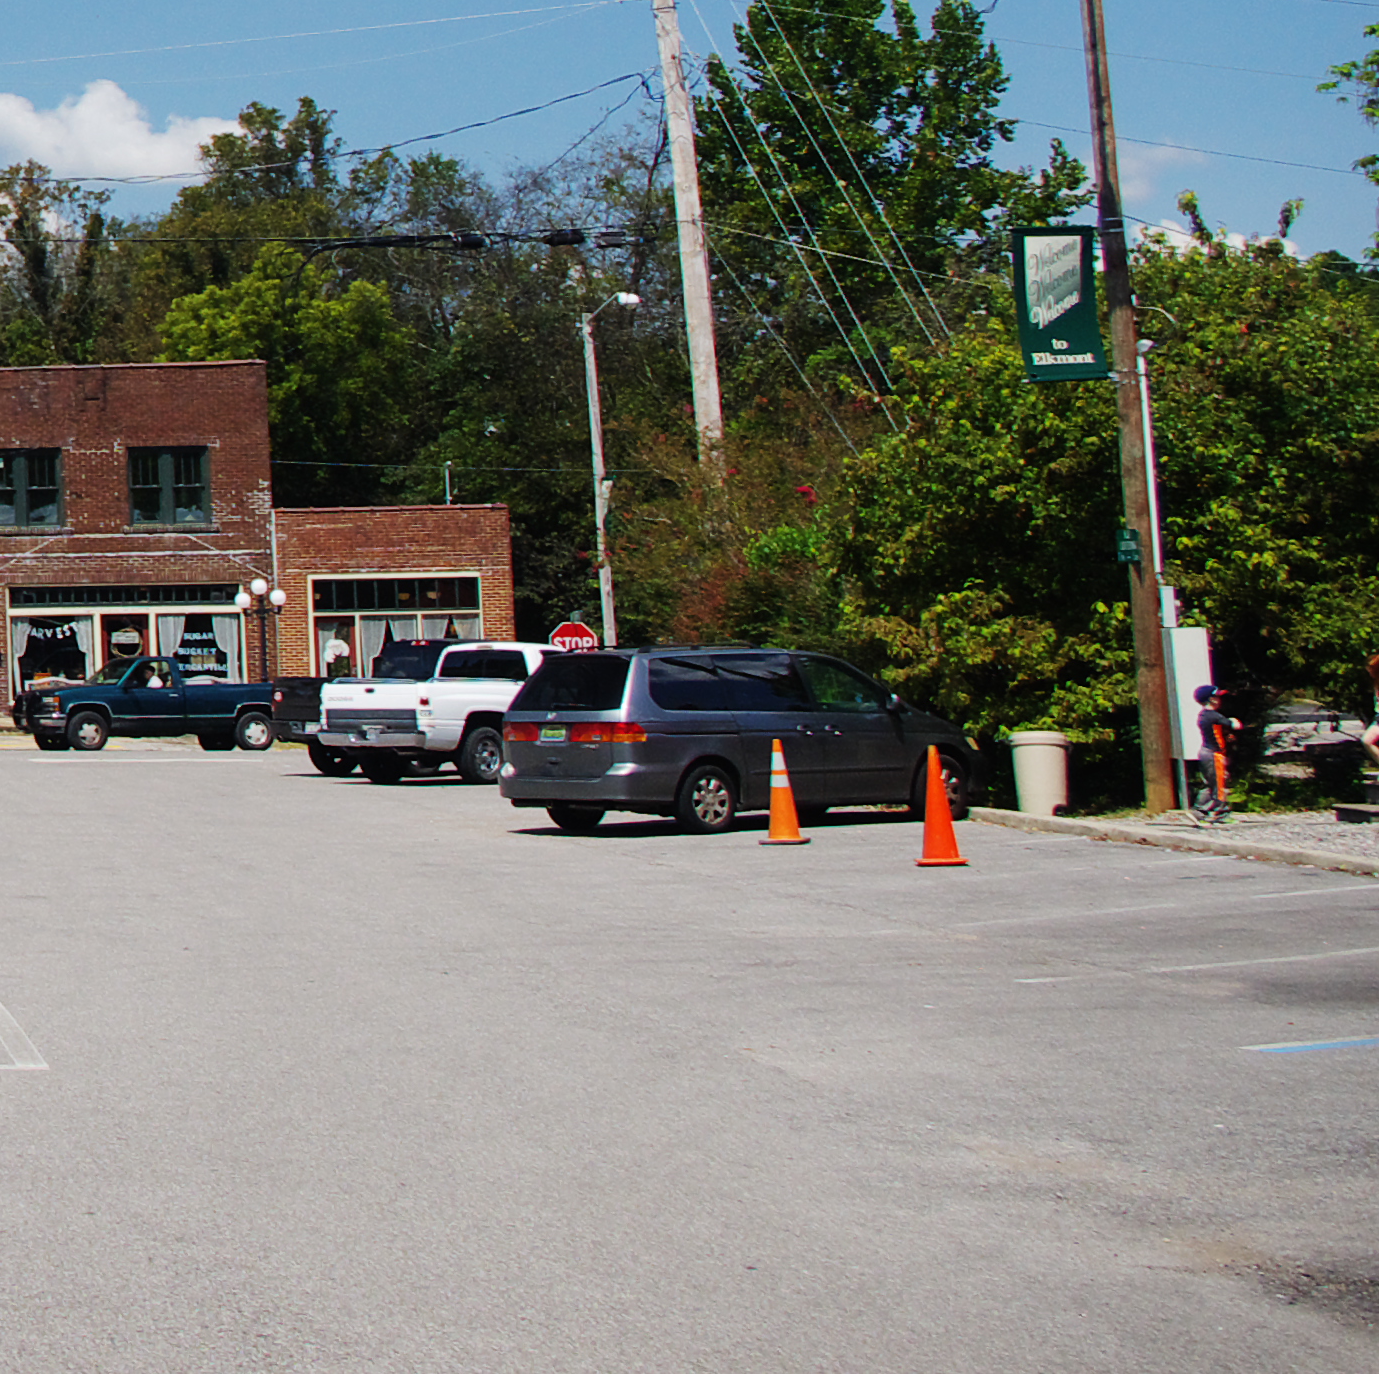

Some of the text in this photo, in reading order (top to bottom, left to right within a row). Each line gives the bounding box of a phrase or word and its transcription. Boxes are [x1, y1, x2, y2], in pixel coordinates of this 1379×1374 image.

[1029, 290, 1081, 330] Welcome
[1051, 338, 1069, 350] to
[1031, 352, 1096, 366] Elkmont
[183, 632, 214, 641] SUGAR
[553, 636, 594, 650] STOP
[177, 647, 217, 656] BUCKET
